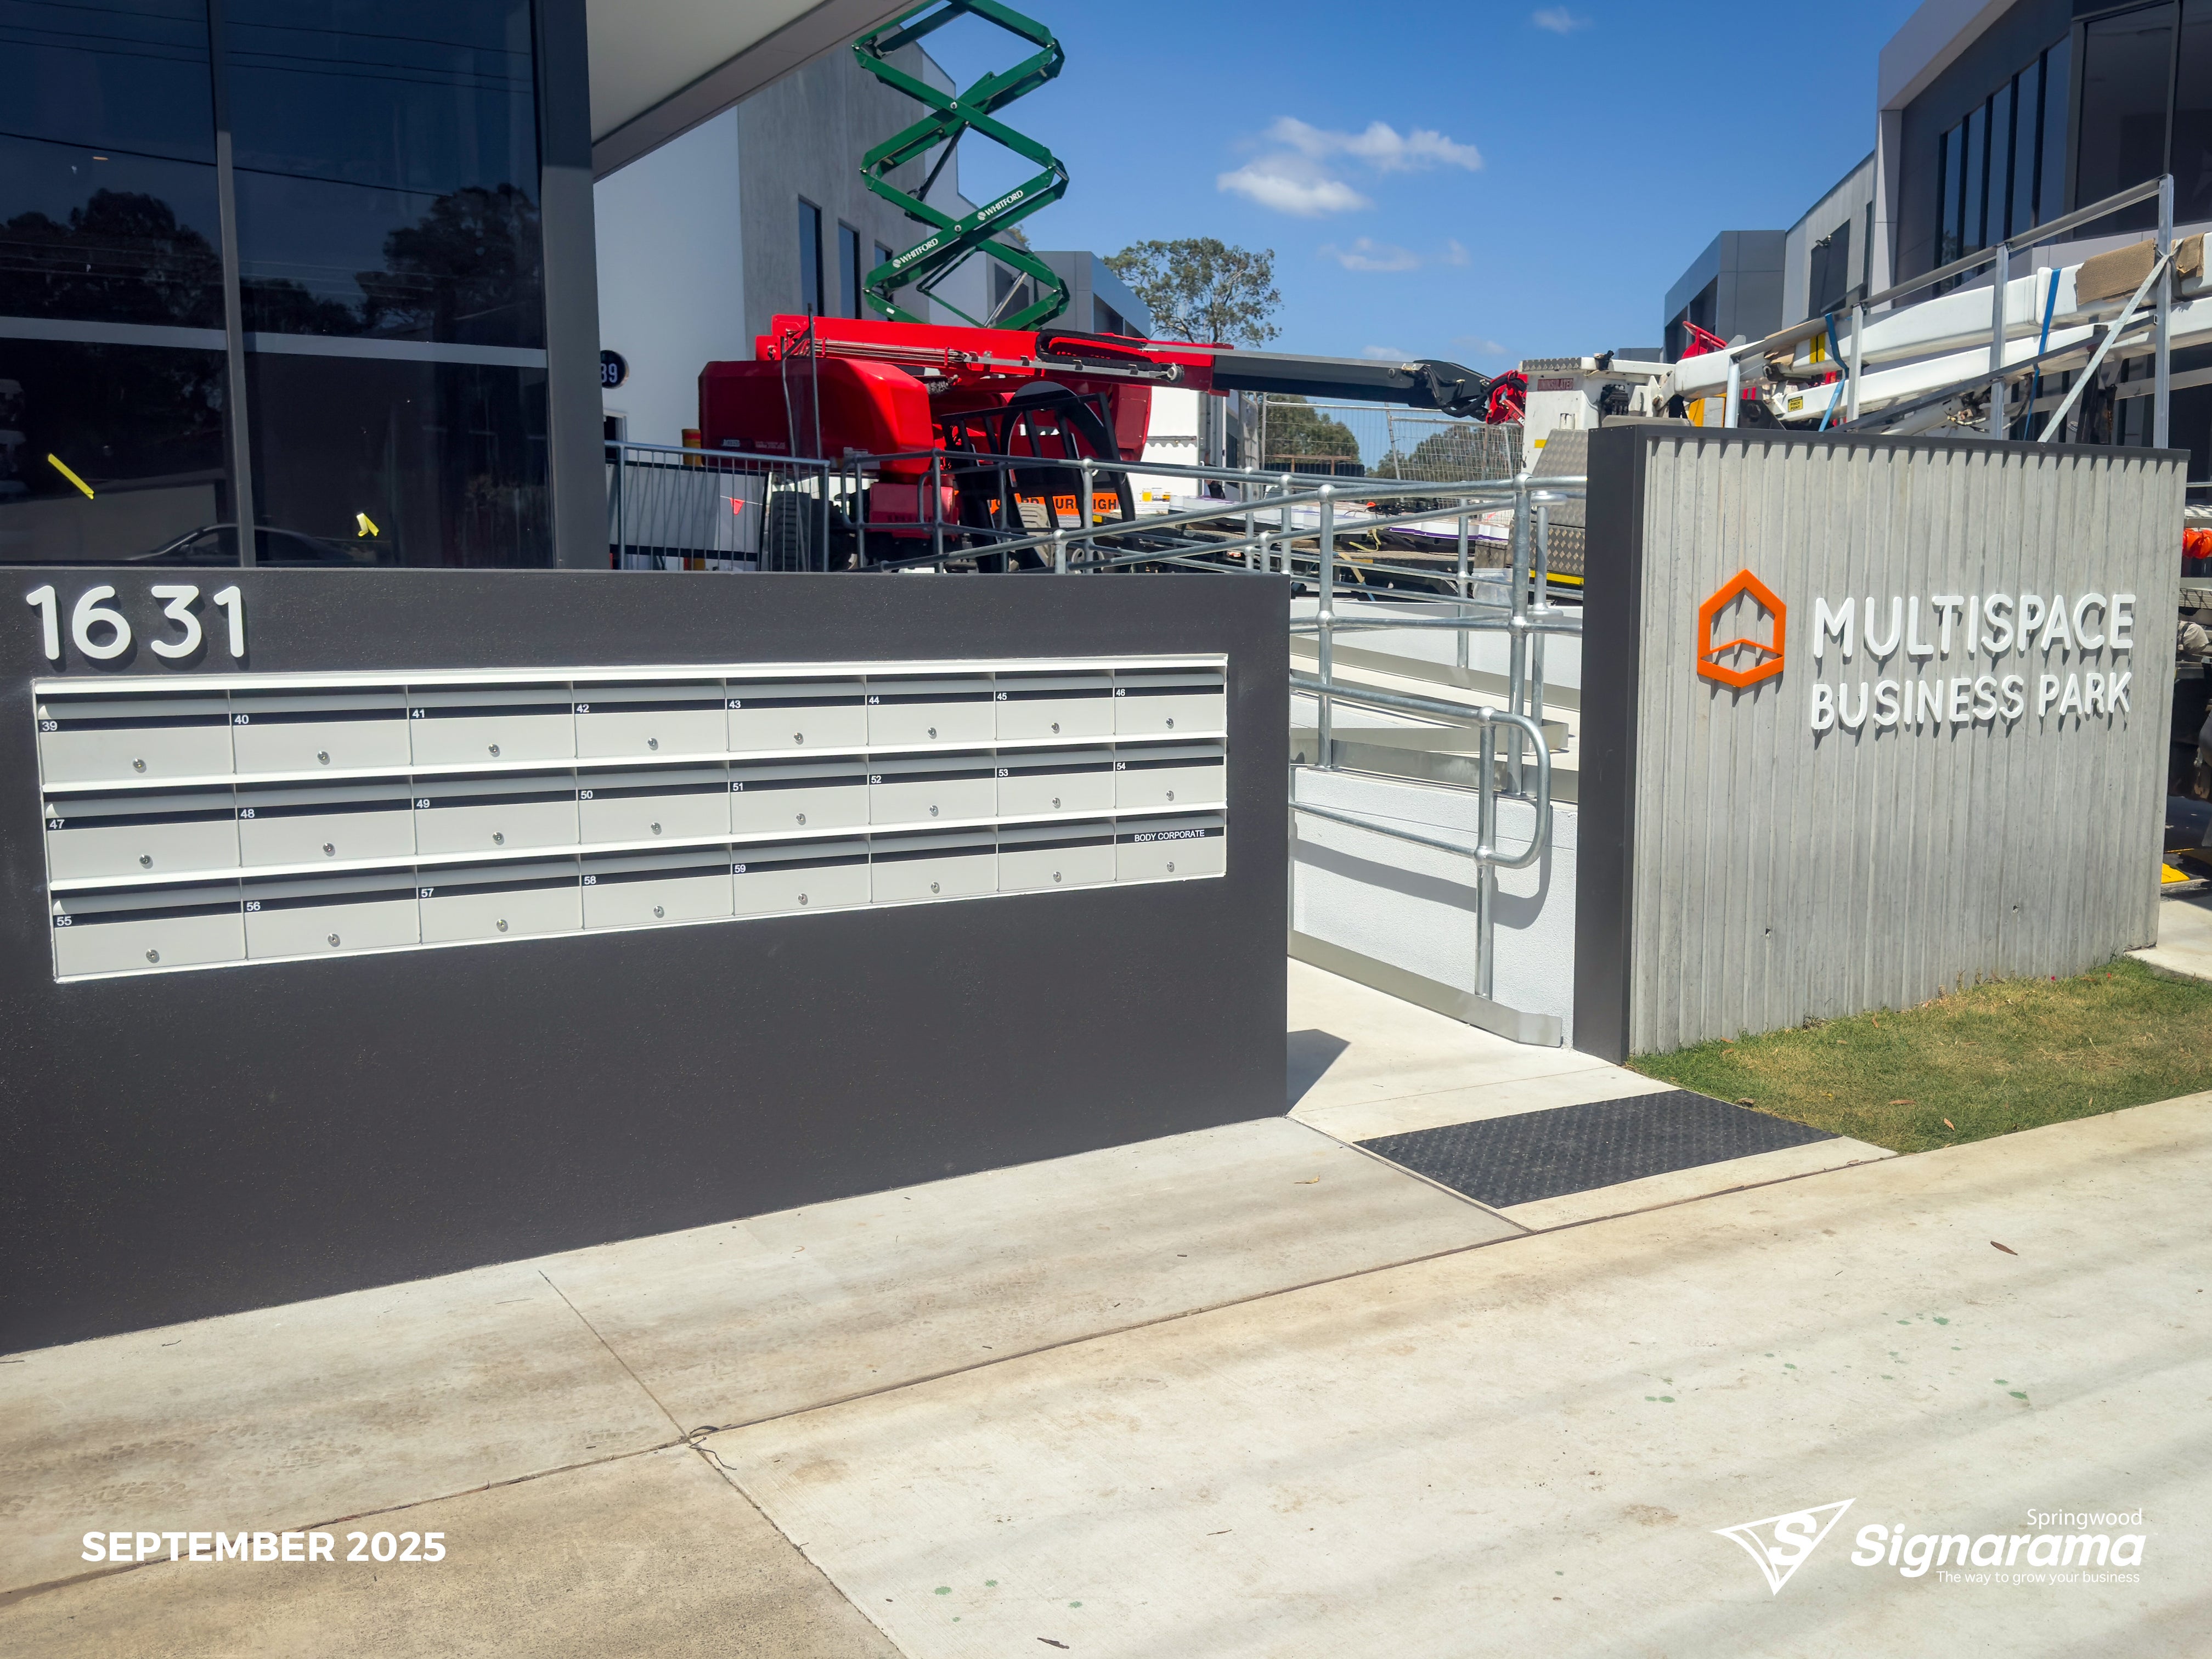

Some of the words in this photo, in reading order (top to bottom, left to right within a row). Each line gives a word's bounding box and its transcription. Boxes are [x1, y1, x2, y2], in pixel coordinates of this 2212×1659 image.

[984, 189, 1024, 216] WHITFORD
[899, 238, 939, 263] WHITFORD
[26, 584, 245, 660] 1631
[1813, 592, 2137, 659] MULTISPACE
[997, 692, 1007, 701] 45
[1116, 689, 1126, 697] 46
[729, 699, 741, 709] 43
[868, 696, 880, 704] 44
[1810, 674, 2024, 730] BUSINESS
[2038, 671, 2132, 718] PARK
[412, 708, 425, 719] 41
[576, 704, 590, 713] 42
[234, 714, 249, 725] 40
[42, 720, 58, 732] 39
[1116, 762, 1126, 770] 54
[998, 768, 1009, 777] 53
[871, 775, 882, 784] 52
[732, 782, 743, 792] 51
[580, 790, 594, 799] 50
[416, 799, 430, 809] 49
[240, 809, 255, 819] 48
[49, 819, 65, 830] 47
[1134, 833, 1156, 842] BODY
[1158, 829, 1205, 840] CORPORATE
[734, 864, 746, 873] 59
[584, 875, 597, 885] 58
[421, 888, 435, 898] 57
[246, 901, 261, 912] 56
[57, 916, 72, 927] 55
